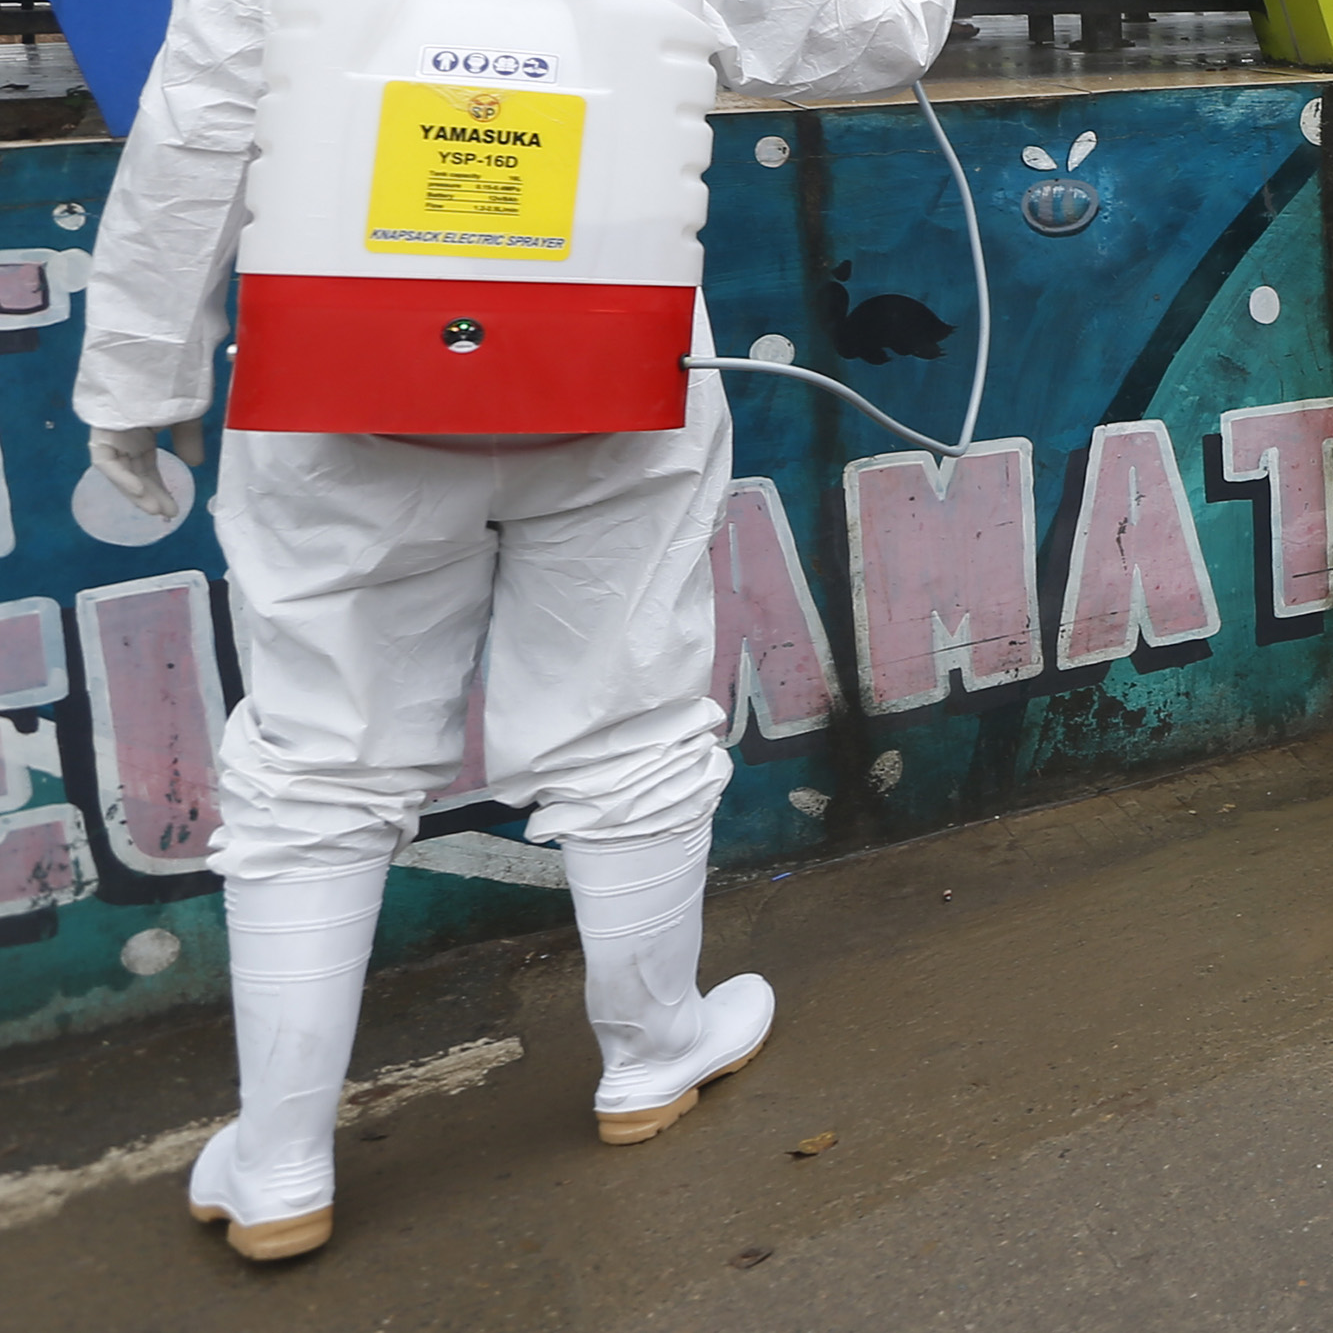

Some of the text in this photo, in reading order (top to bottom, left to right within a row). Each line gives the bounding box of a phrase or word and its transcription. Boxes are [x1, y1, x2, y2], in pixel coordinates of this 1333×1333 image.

[419, 125, 542, 148] YAMASUKA
[438, 151, 518, 168] YSP-16D
[370, 229, 566, 249] KNAPSACK ELECTRIC SPRAYER
